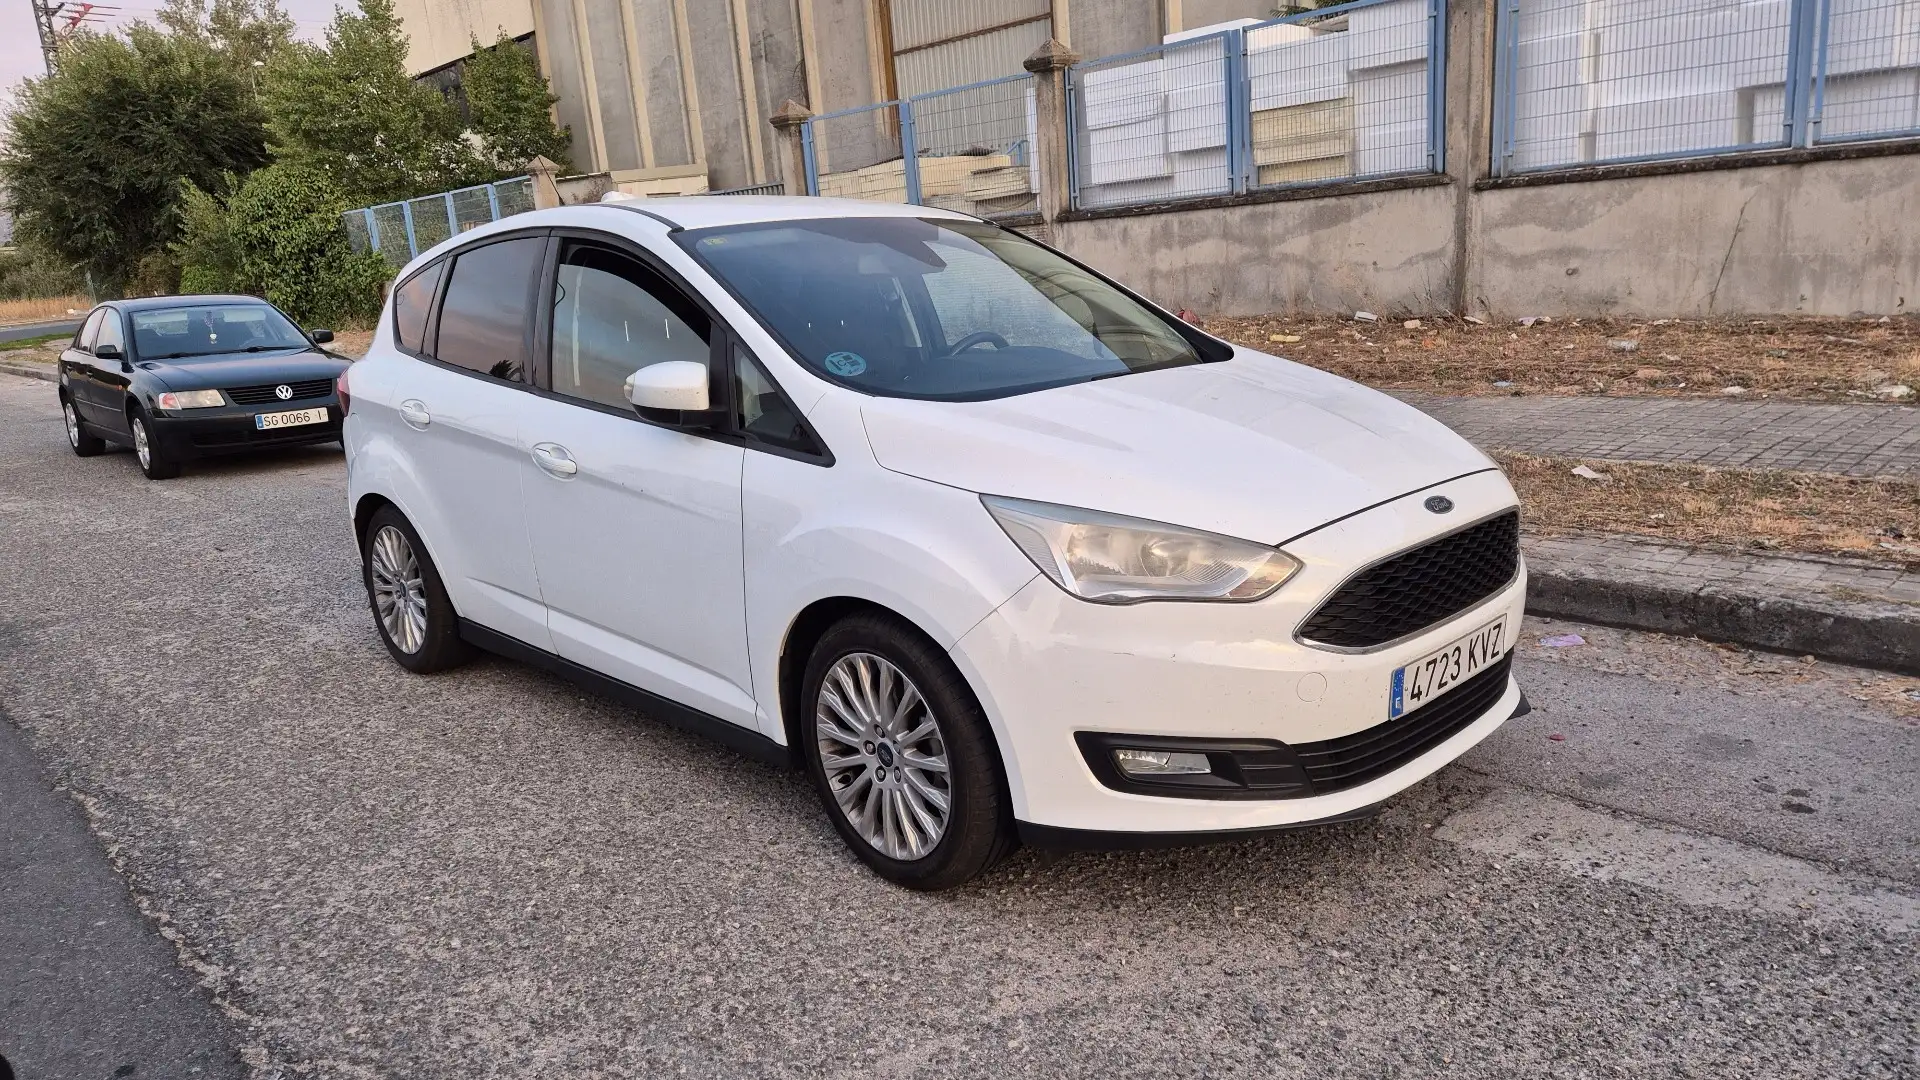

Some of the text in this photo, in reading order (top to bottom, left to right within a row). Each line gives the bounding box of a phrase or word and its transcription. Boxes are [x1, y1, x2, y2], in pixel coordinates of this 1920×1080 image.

[263, 415, 279, 427] SG
[281, 411, 311, 425] 0066
[1410, 622, 1503, 702] 4723 KVZ
